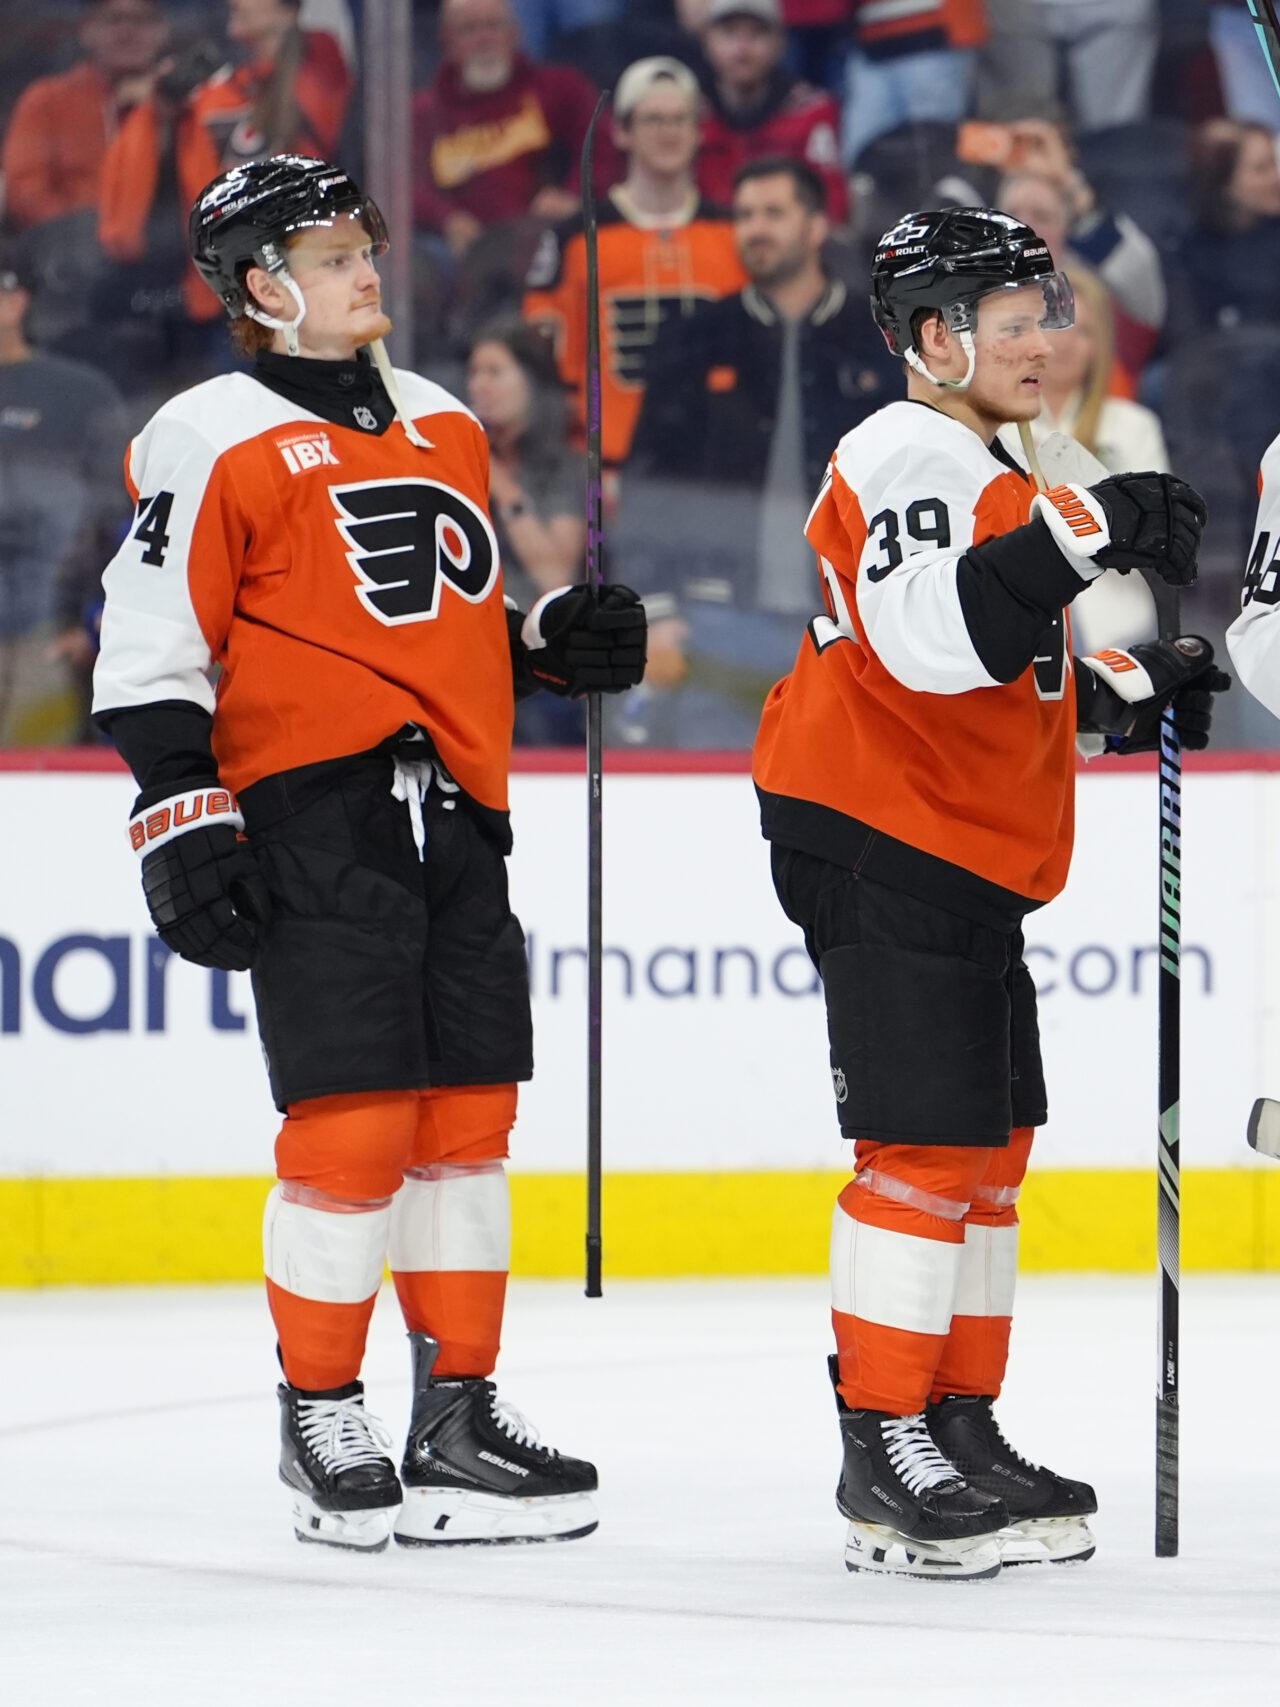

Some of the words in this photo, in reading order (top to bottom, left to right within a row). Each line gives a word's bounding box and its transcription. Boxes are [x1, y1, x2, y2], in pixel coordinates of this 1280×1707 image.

[875, 244, 927, 263] CHEVROLET
[280, 439, 341, 476] IBX
[866, 497, 952, 584] 39
[0, 932, 247, 1035] art
